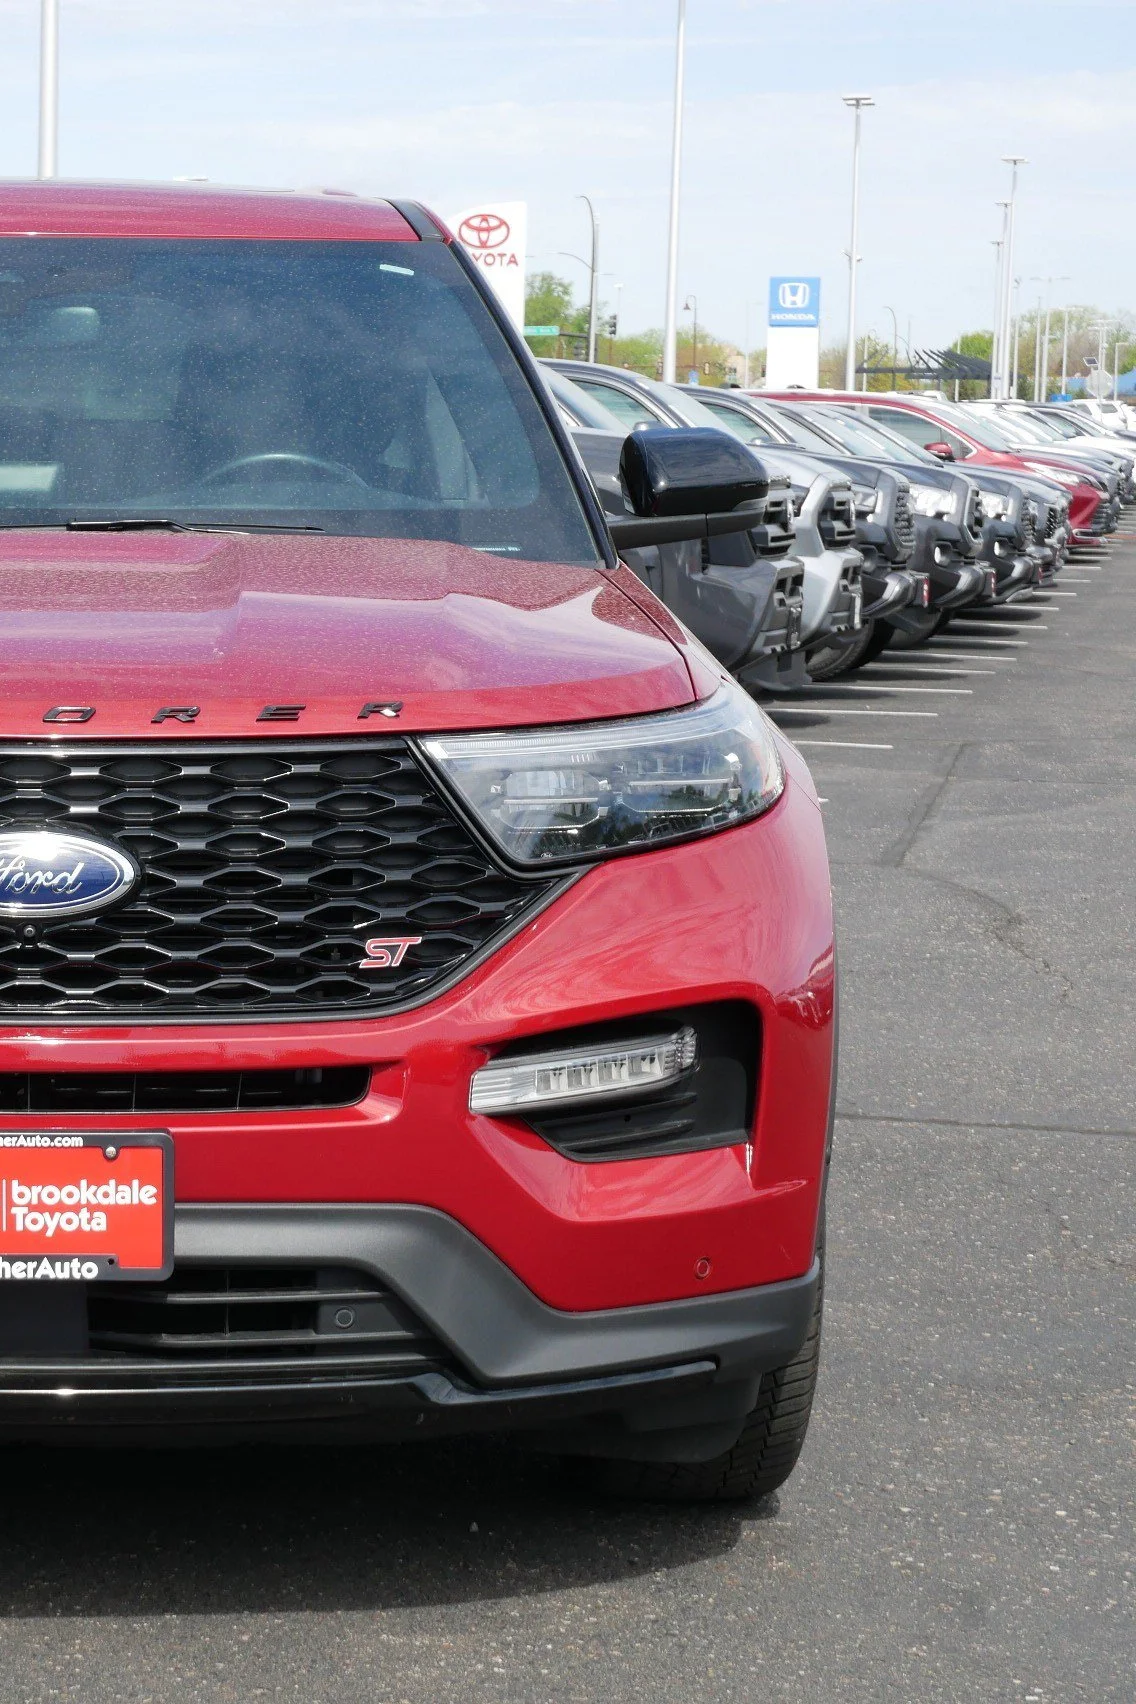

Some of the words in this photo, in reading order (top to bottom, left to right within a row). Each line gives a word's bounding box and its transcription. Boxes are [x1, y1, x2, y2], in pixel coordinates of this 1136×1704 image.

[471, 252, 519, 267] YOTA
[359, 936, 423, 969] ST
[11, 1179, 158, 1206] brookdale
[11, 1207, 107, 1237] Toyota
